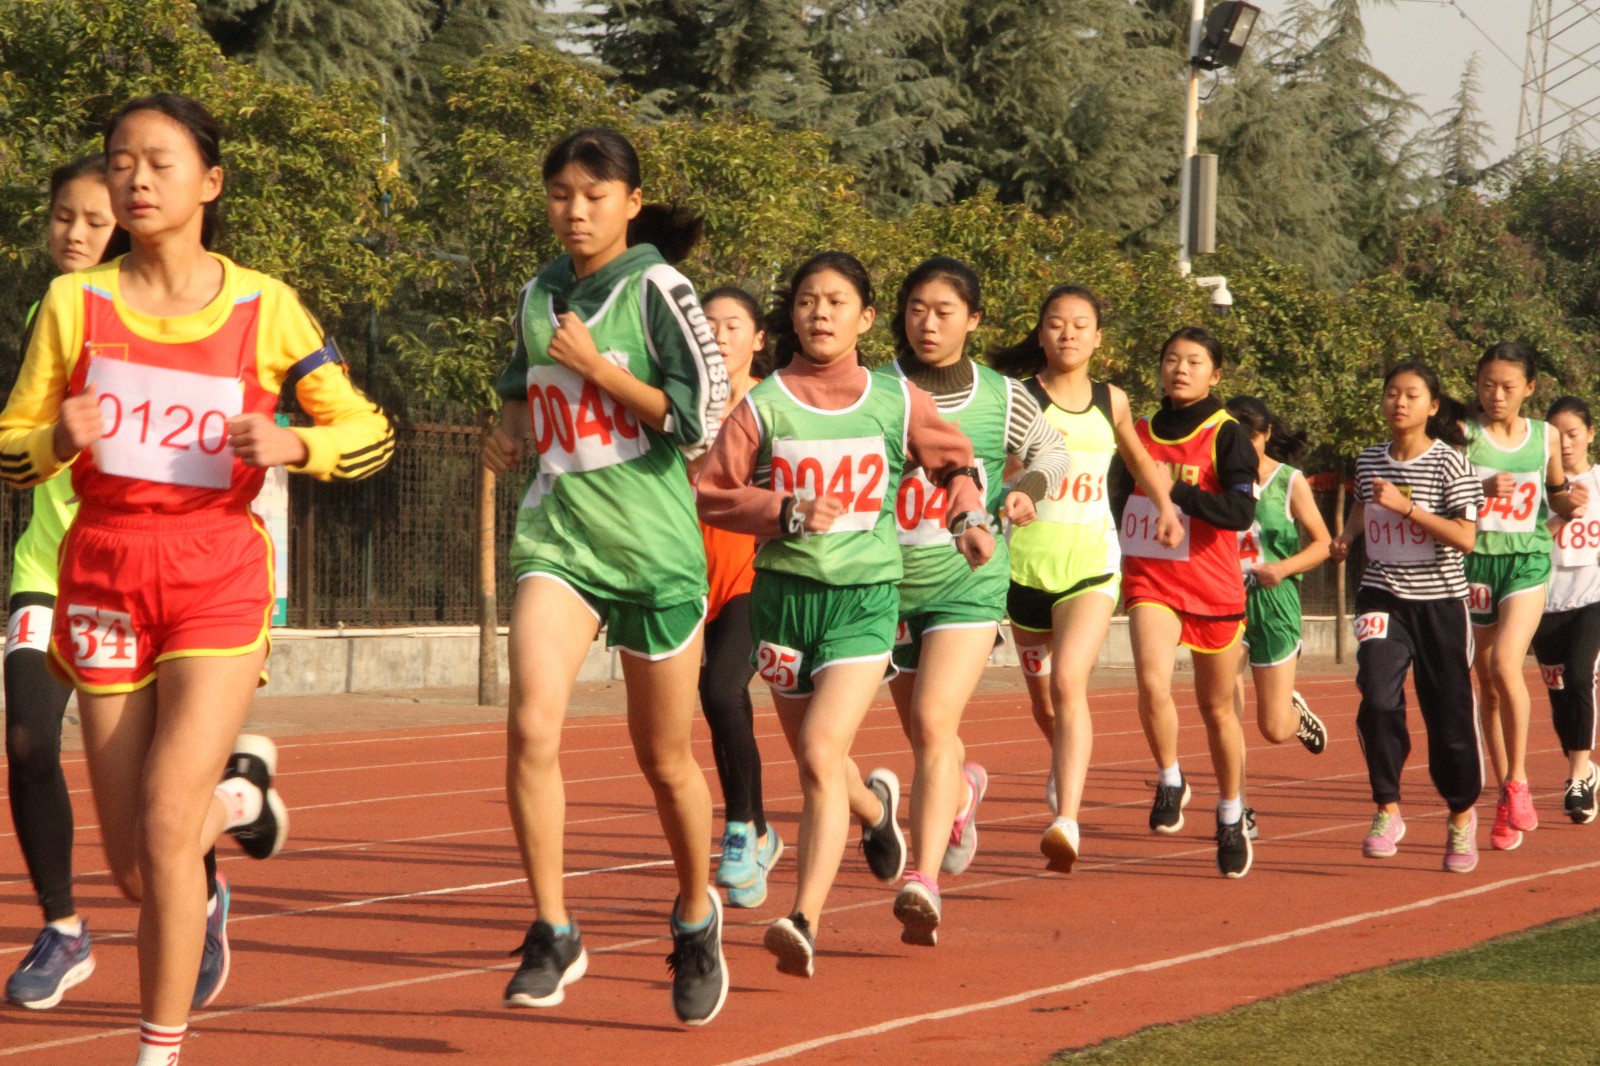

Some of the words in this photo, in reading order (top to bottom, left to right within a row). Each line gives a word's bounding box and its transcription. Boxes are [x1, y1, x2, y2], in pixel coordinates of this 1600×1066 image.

[98, 392, 230, 455] 0120
[770, 453, 884, 512] 0042
[1369, 519, 1426, 544] 0119
[69, 614, 133, 660] 34
[1356, 616, 1385, 641] 29
[760, 647, 797, 687] 25
[1022, 650, 1042, 673] 6
